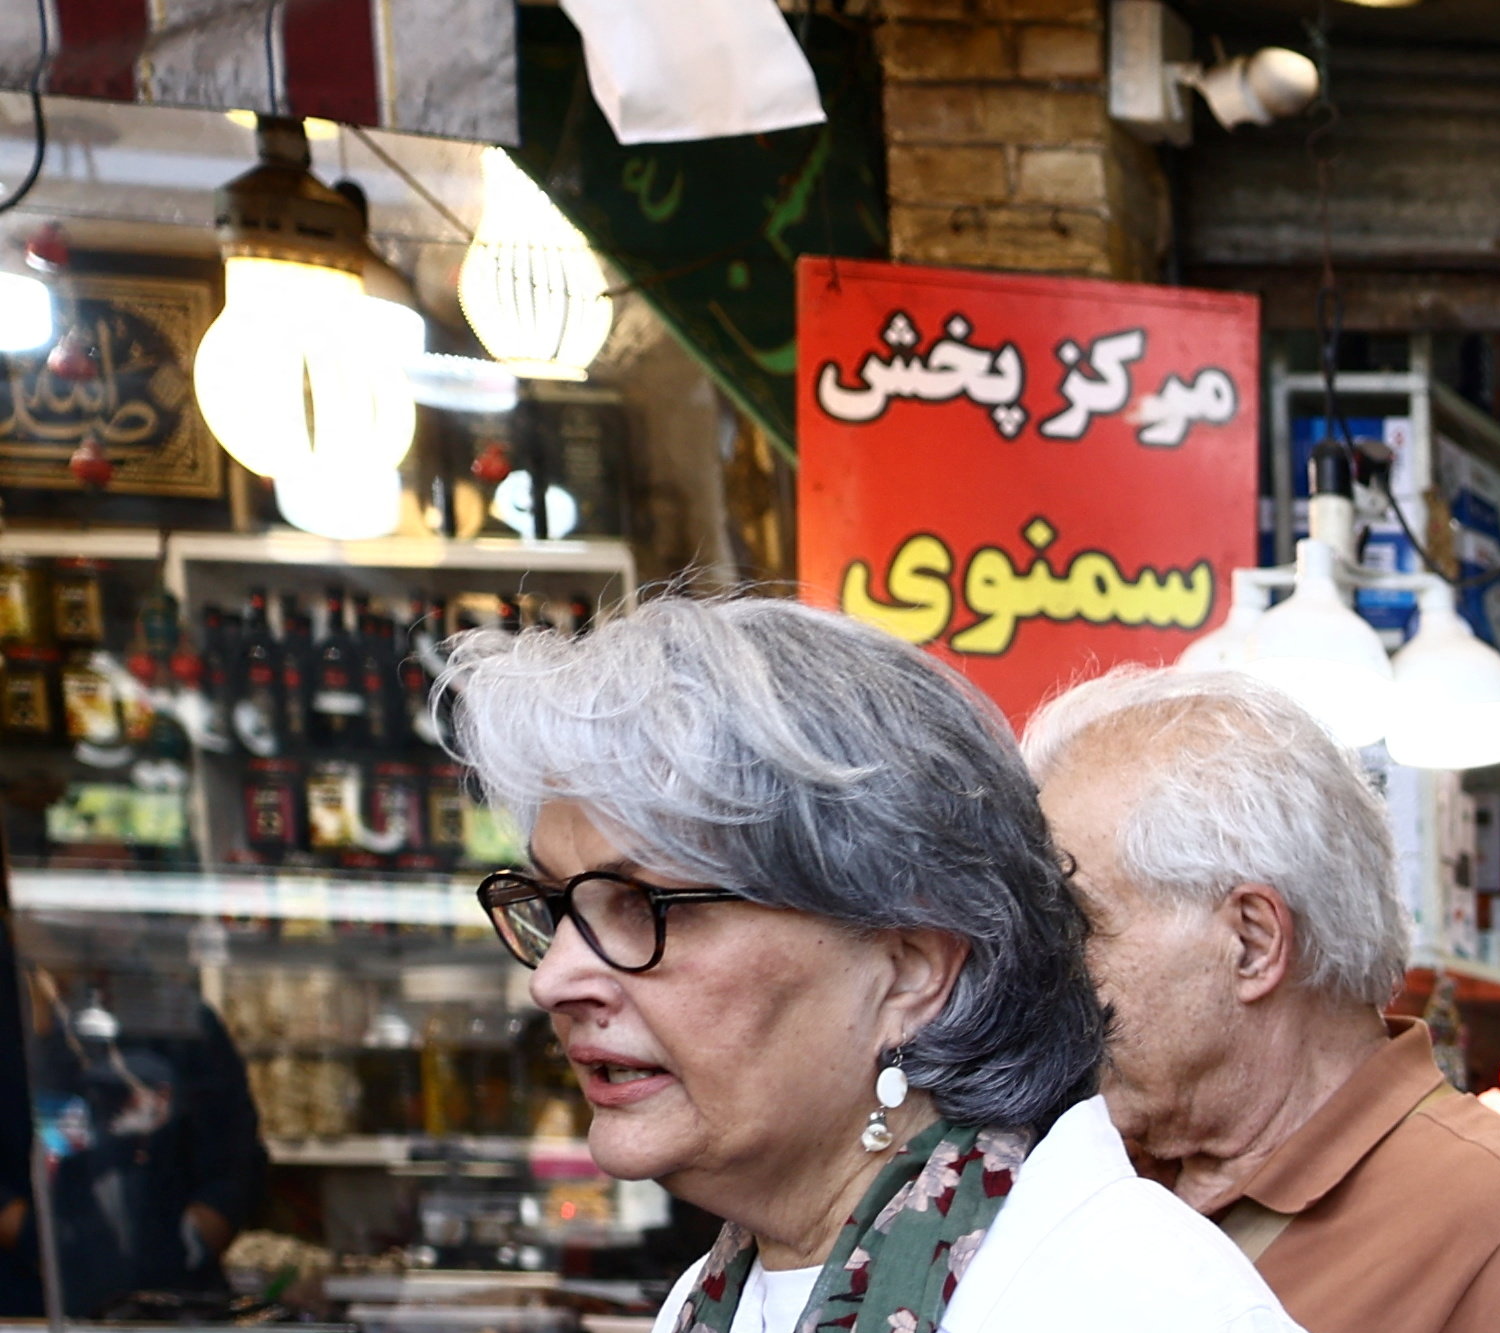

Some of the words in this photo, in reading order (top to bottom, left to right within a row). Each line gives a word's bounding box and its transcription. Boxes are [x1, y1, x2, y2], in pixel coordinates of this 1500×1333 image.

[816, 310, 1029, 439] پخش
[1038, 327, 1239, 450] مرکز
[839, 516, 1216, 656] سمنوی
